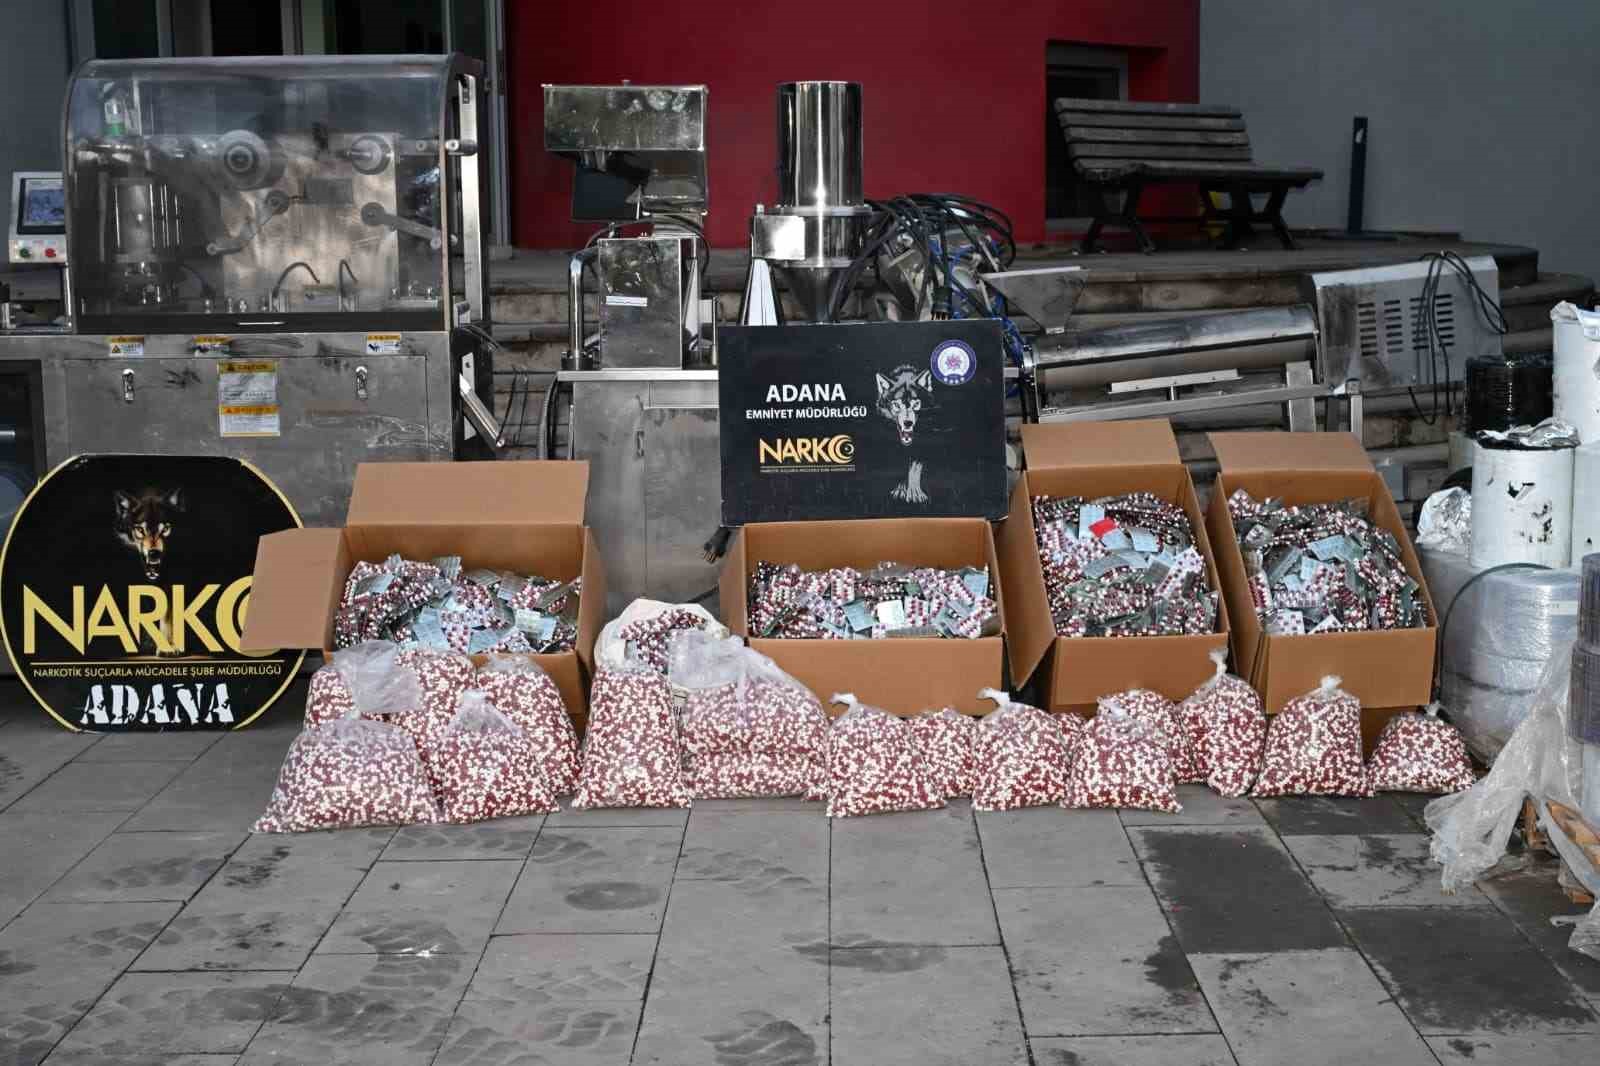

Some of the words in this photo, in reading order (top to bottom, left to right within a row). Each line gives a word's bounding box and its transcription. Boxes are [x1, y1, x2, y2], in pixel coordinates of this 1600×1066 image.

[766, 383, 847, 402] ADANA
[745, 407, 794, 419] EMNİYET
[796, 405, 868, 419] MÜDÜRLÜĞÜ
[759, 434, 855, 464] NARKO
[33, 666, 82, 678] NARKOTİK
[84, 666, 132, 679] SUÇLARLA
[135, 664, 188, 677] MÜCADELE
[191, 665, 215, 678] ŞUBE
[217, 663, 281, 676] MÜDÜRLÜĞÜ
[80, 683, 235, 725] ADANA
